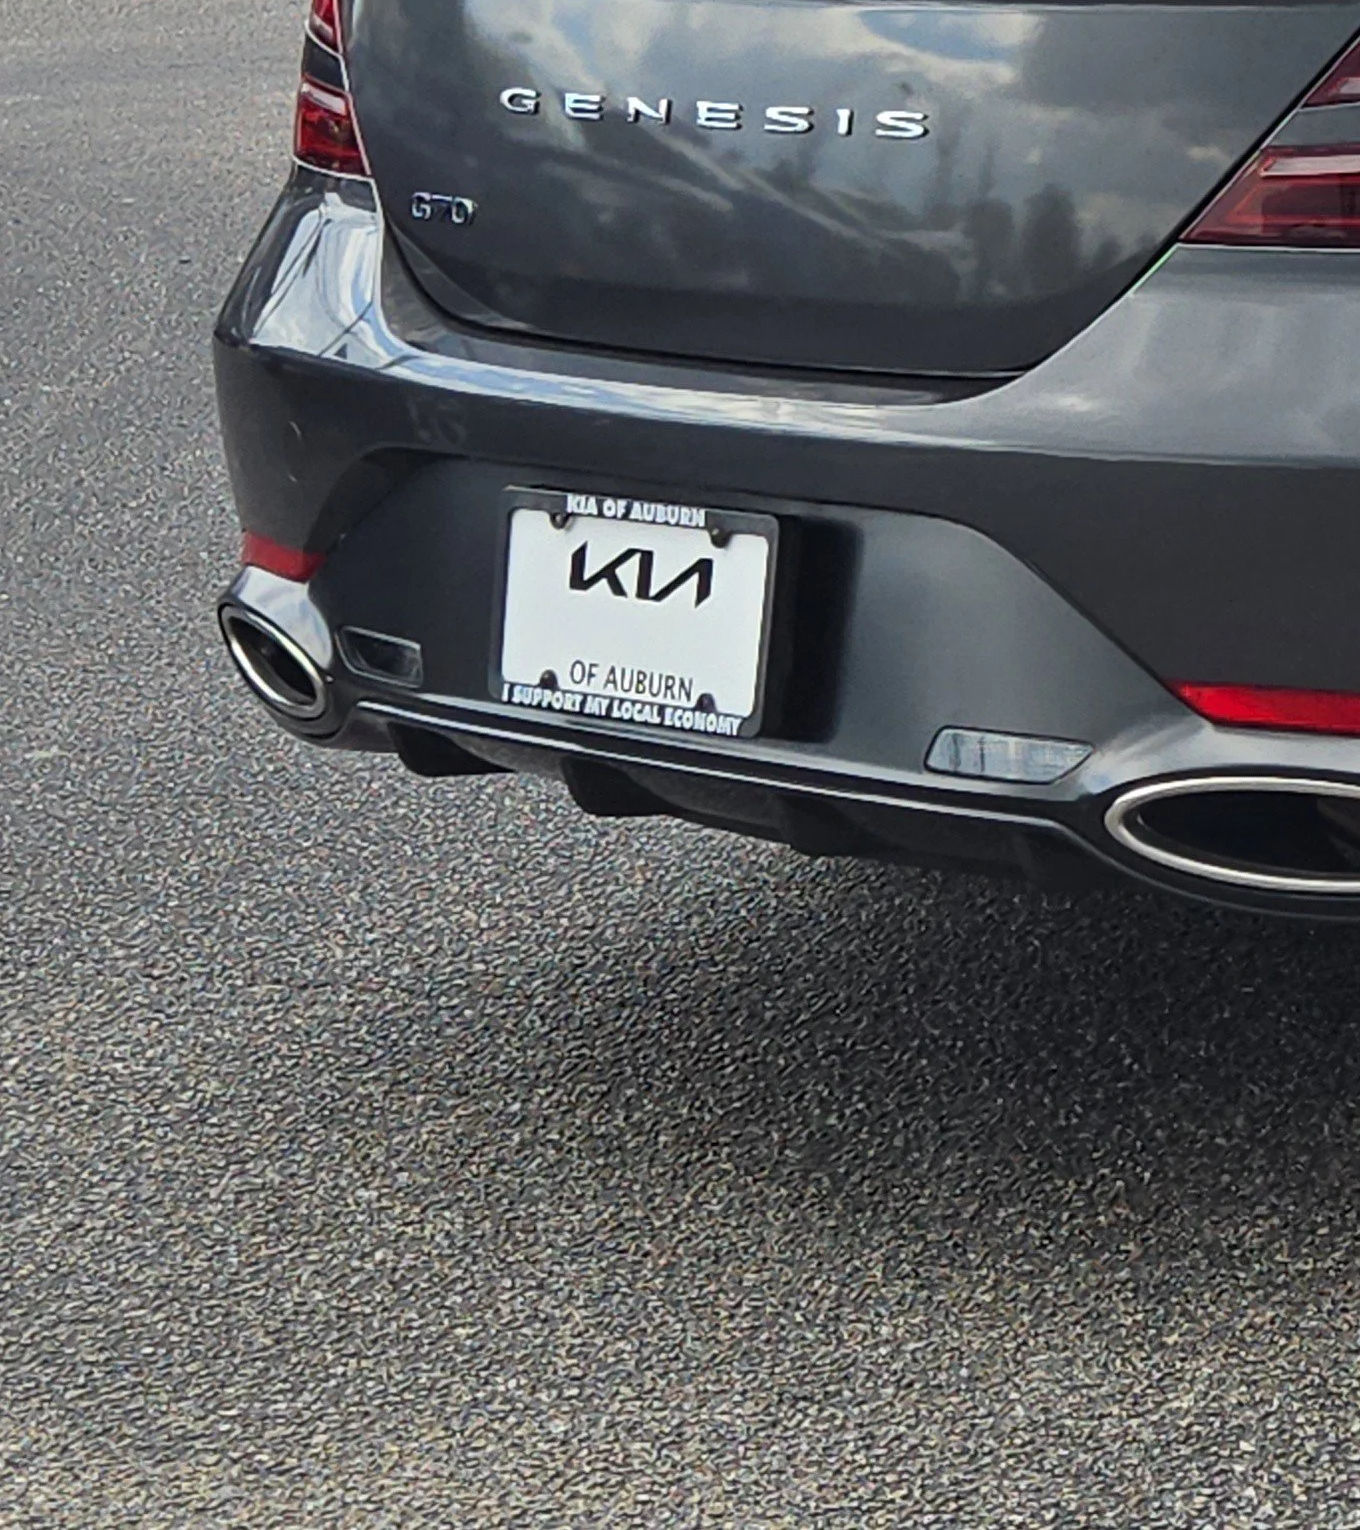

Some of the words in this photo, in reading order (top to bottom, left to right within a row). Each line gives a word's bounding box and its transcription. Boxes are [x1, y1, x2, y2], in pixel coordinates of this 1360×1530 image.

[500, 87, 930, 139] GENESIS
[411, 191, 479, 225] G70
[565, 494, 598, 516] KIA
[602, 498, 626, 519] OF
[628, 501, 706, 528] AUBURN
[569, 540, 714, 608] KIA
[570, 659, 599, 686] OF
[603, 665, 694, 703] AUBURN
[501, 683, 510, 703] I
[511, 685, 584, 712] SUPPORT
[584, 694, 610, 718] MY
[611, 698, 662, 725] LOCAL
[664, 708, 742, 737] ECONOMY
